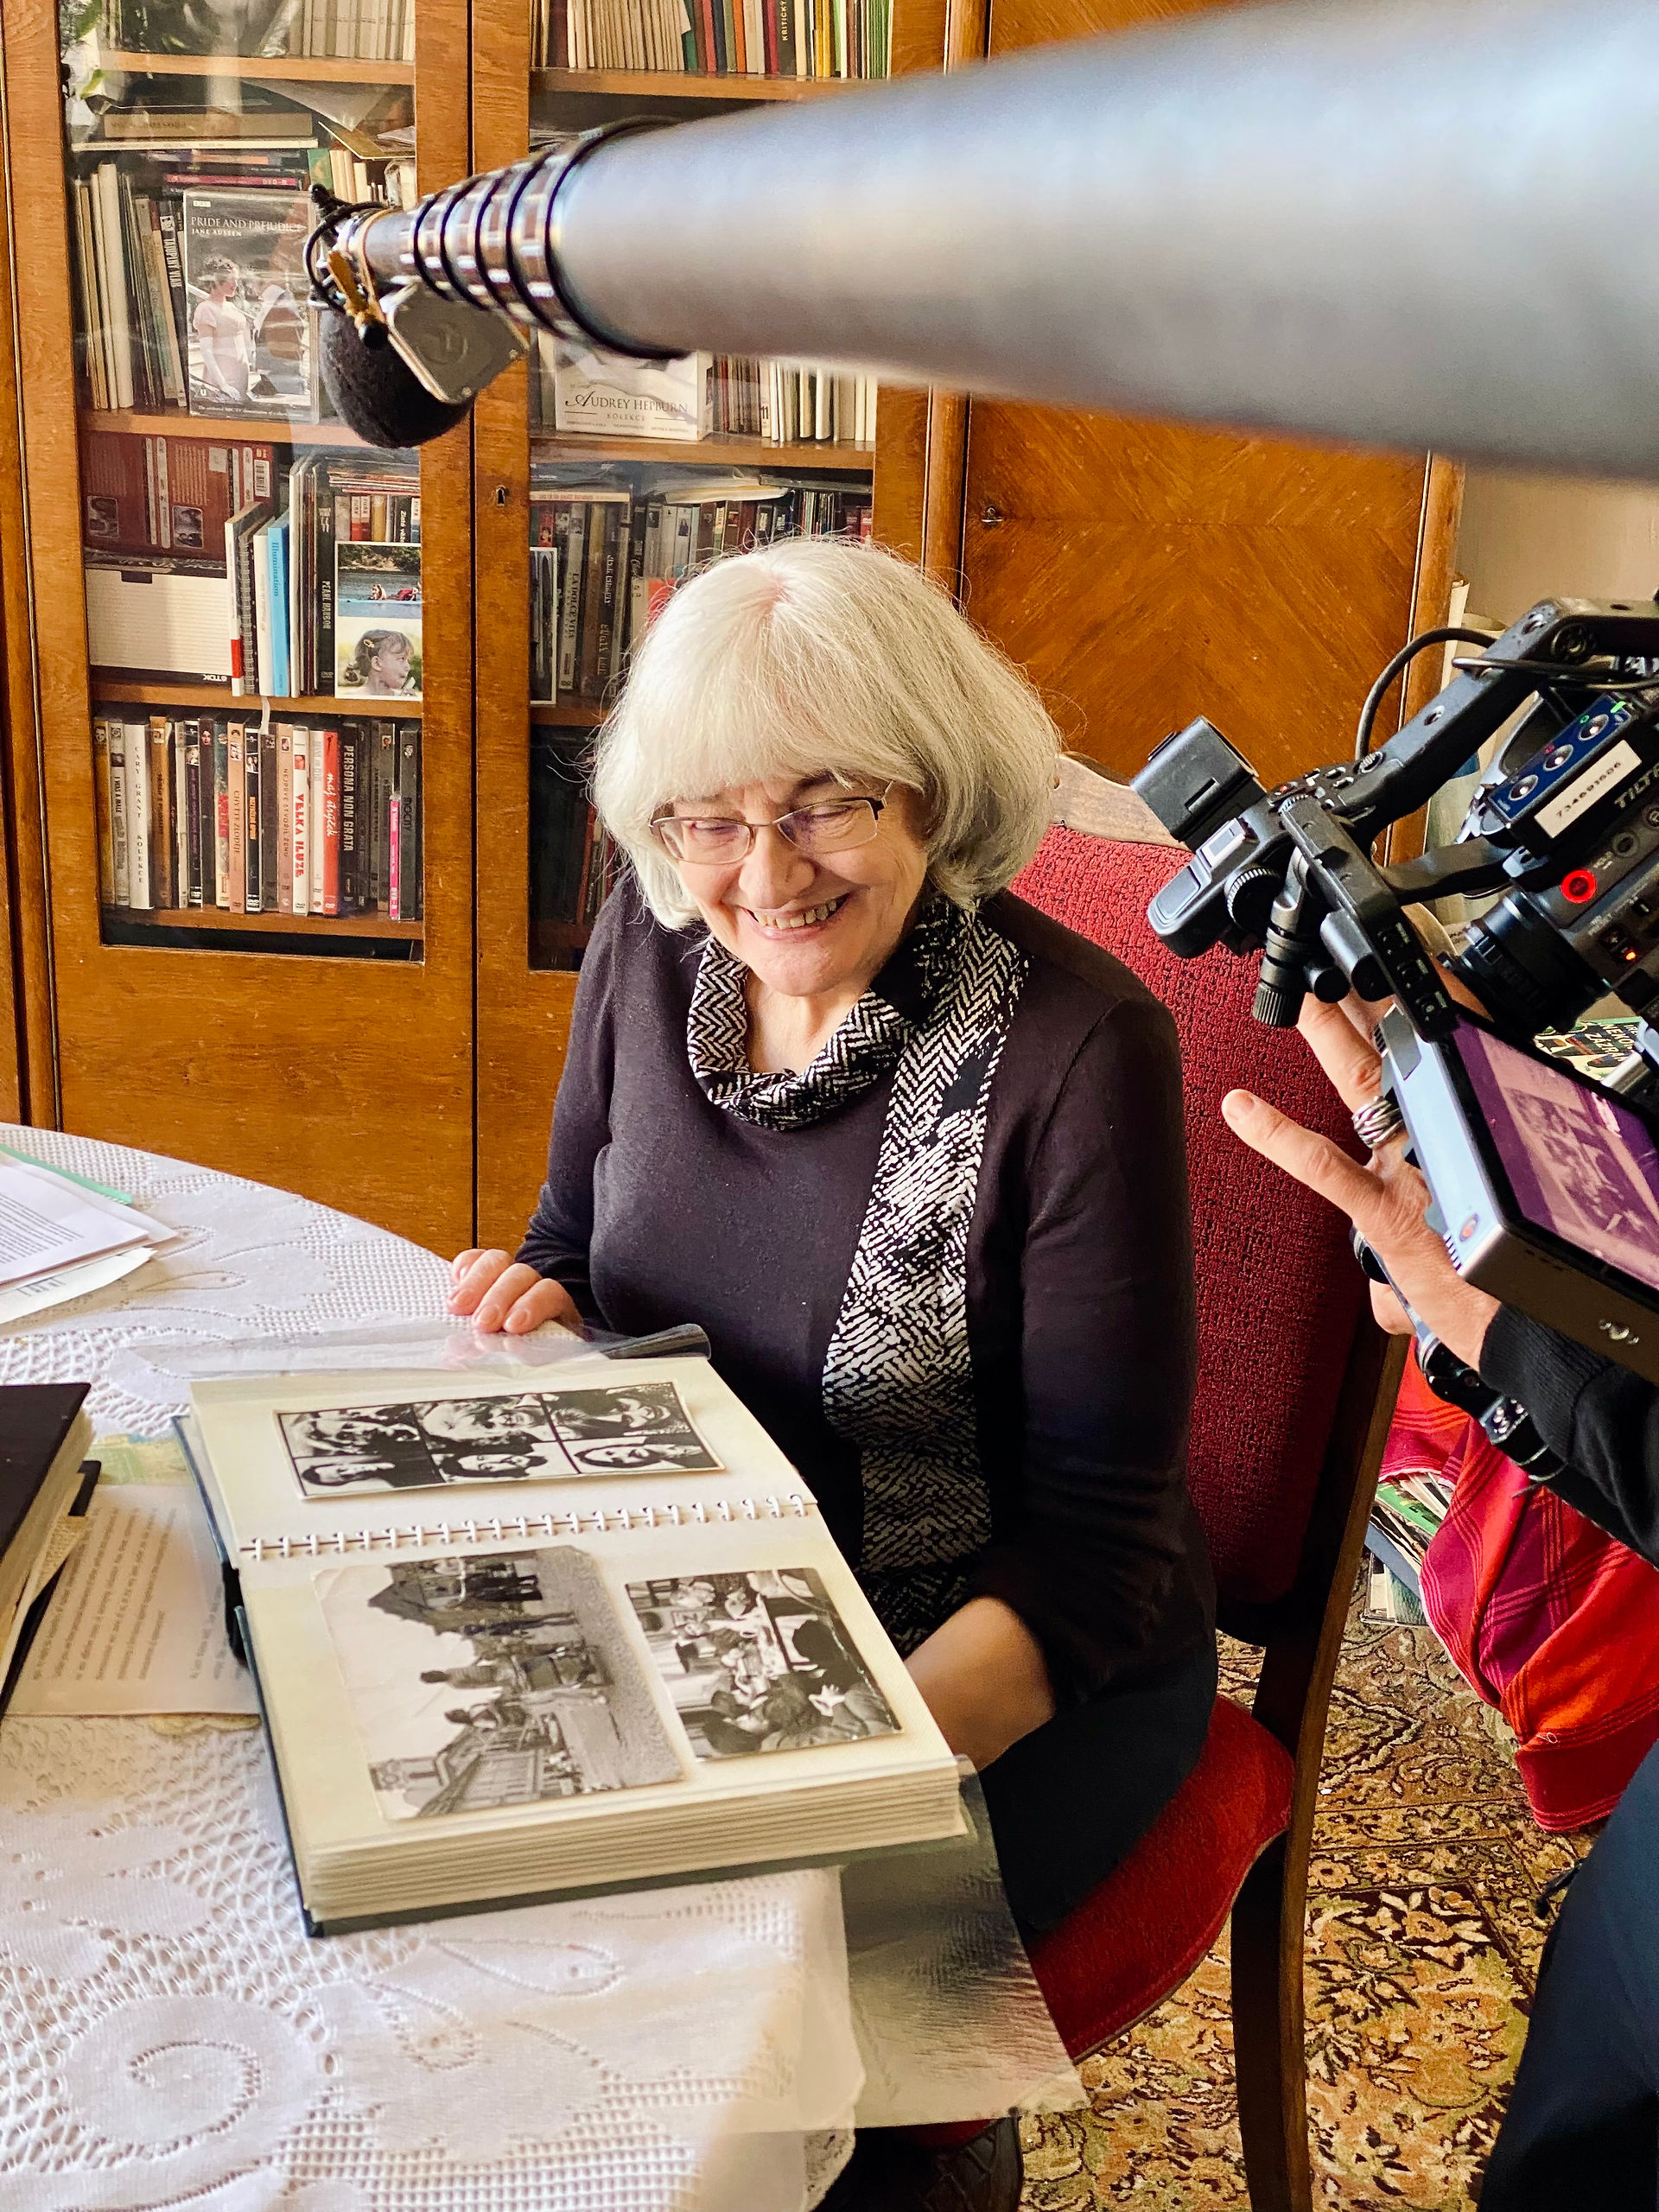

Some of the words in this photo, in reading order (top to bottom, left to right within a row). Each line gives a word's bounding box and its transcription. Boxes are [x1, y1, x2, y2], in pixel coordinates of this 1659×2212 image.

[191, 216, 220, 226] PRIDE
[221, 218, 245, 228] AND
[163, 238, 180, 269] TAJUPLNÝ
[169, 270, 182, 288] VLAK
[565, 391, 631, 409] AUDREY
[634, 399, 688, 413] HEPBURN
[271, 541, 280, 596] Illumination
[572, 573, 579, 584] LA
[321, 581, 332, 601] PEARL
[569, 586, 578, 617] DOLCE
[321, 602, 332, 629] HARBOR
[568, 619, 576, 639] VITA
[344, 745, 354, 791] PERSONA
[282, 768, 290, 801] NEJPRVE
[344, 795, 354, 817] NON
[344, 821, 354, 851] GRATA
[296, 841, 304, 878] ILUZE
[1624, 1025, 1638, 1035] IRE
